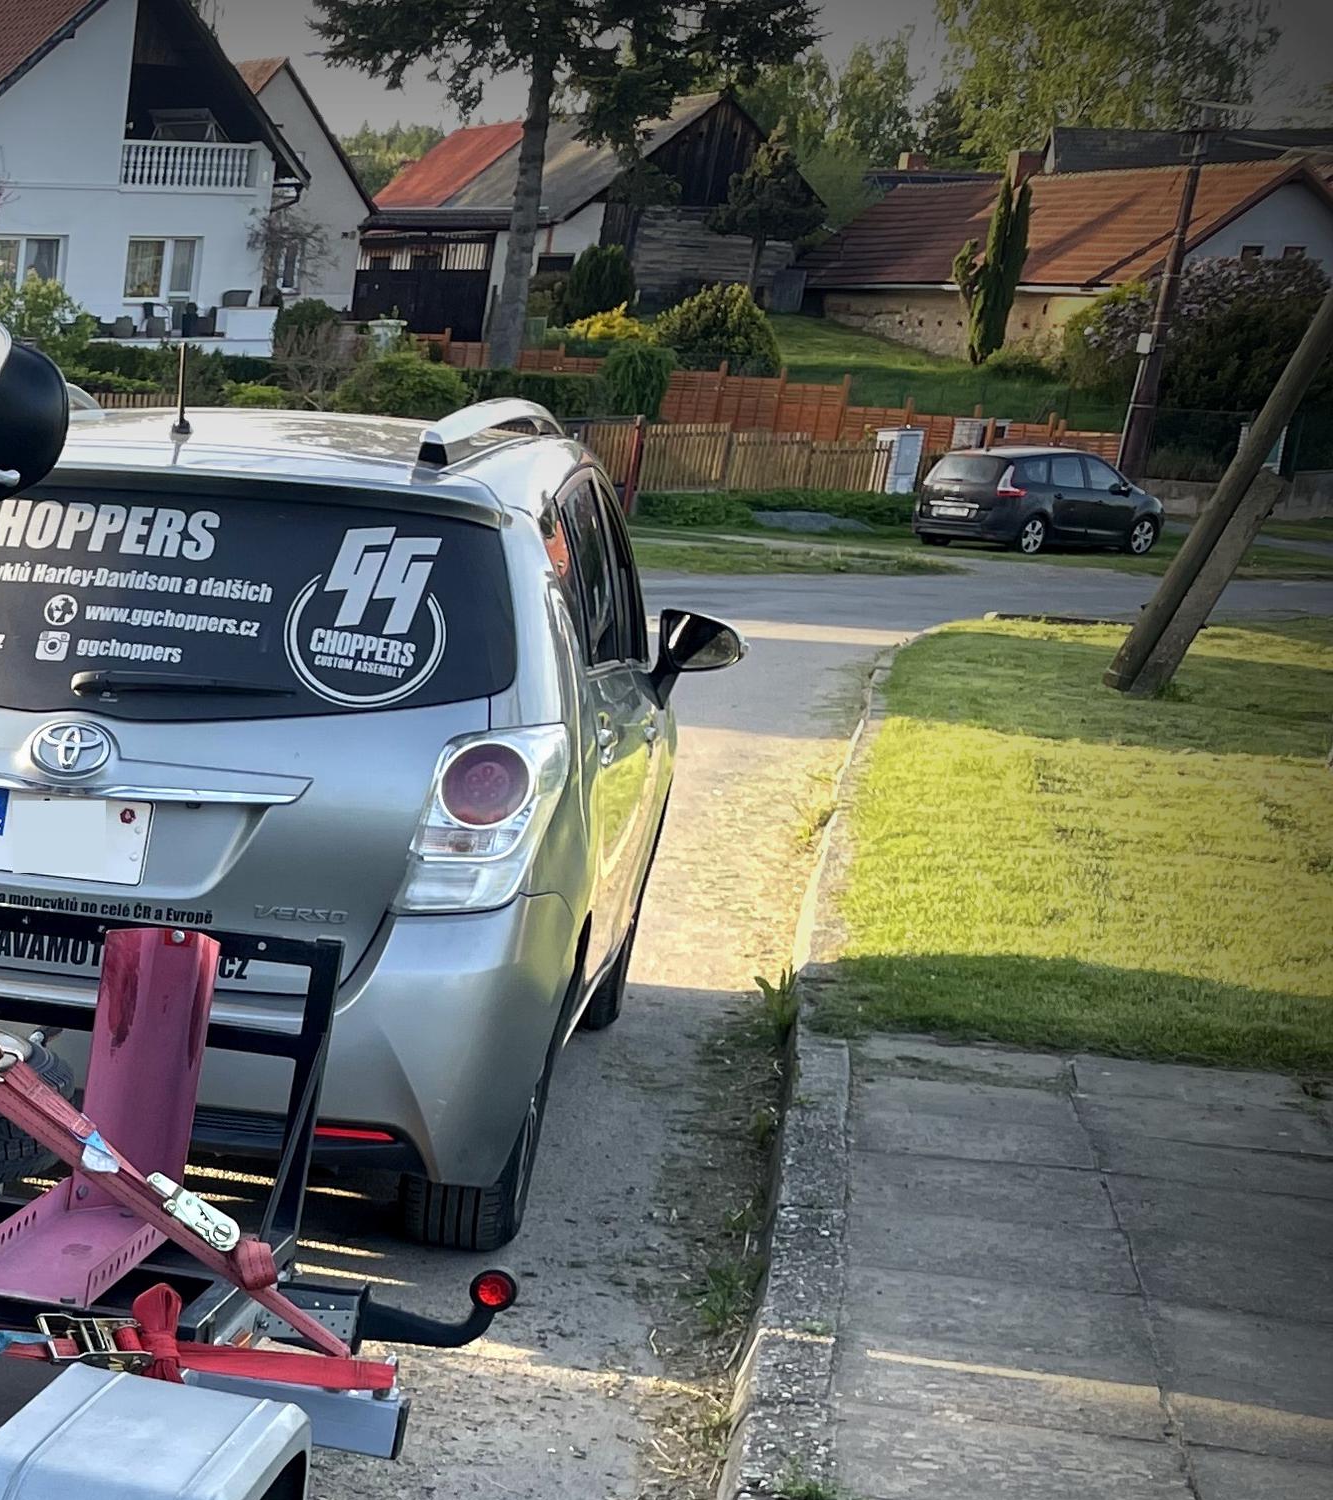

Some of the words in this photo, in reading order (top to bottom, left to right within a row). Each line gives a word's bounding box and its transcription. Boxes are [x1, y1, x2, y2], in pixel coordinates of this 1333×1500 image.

[33, 564, 182, 594] Harley-Davidson
[184, 578, 197, 595] a
[199, 576, 274, 604] dalších
[85, 604, 261, 637] www.ggchoppers.cz
[76, 638, 182, 664] ggchoppers
[309, 628, 417, 667] CHOPPERS
[314, 655, 353, 671] CUSTOM
[354, 660, 406, 679] ASSEMBLY
[100, 903, 130, 917] celé
[133, 902, 151, 919] ČR
[154, 909, 162, 920] a
[165, 907, 213, 924] Evropě
[254, 904, 349, 924] VERSO
